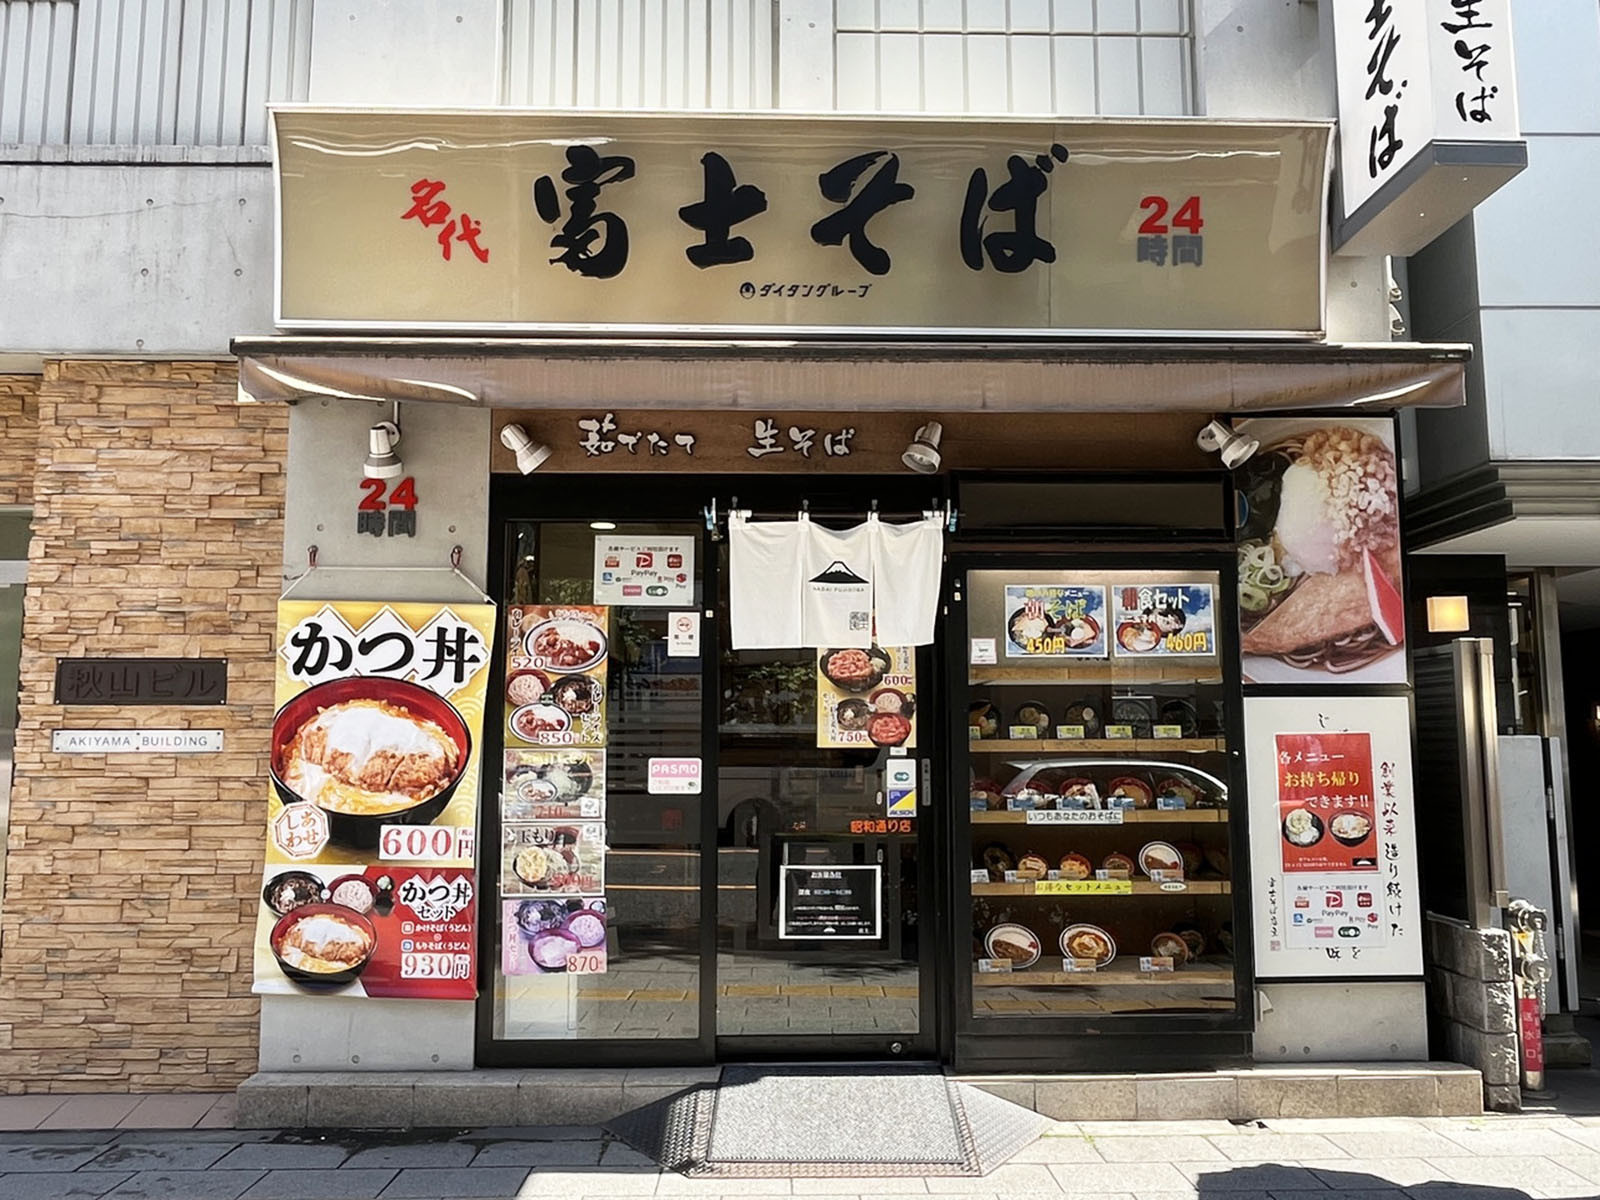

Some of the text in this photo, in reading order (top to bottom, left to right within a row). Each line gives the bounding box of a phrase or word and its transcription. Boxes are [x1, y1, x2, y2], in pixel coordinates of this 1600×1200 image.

[402, 144, 1069, 278] 名代 富士そば
[1137, 196, 1204, 234] 24
[1137, 235, 1204, 267] 時間
[760, 283, 872, 297] ダイタングループ
[579, 413, 855, 457] 茹でたて 生そば
[358, 477, 418, 510] 24
[357, 510, 416, 537] 時間
[1122, 587, 1190, 611] 朝食セット
[1027, 637, 1065, 654] 450円
[1166, 632, 1206, 652] 460円
[291, 622, 481, 684] かつ丼
[512, 657, 544, 668] 520
[68, 664, 217, 698] 秋山ビル
[69, 736, 208, 746] AKIYAMA BUILDING
[540, 733, 572, 744] 850
[839, 731, 862, 741] 750
[1280, 751, 1344, 764] 各メニュー
[652, 764, 698, 774] PASMO
[1284, 771, 1360, 788] お持ち帰り
[850, 819, 912, 833] 昭和通り店
[402, 881, 471, 905] かつ丼
[418, 905, 457, 920] セット
[568, 955, 599, 972] 870
